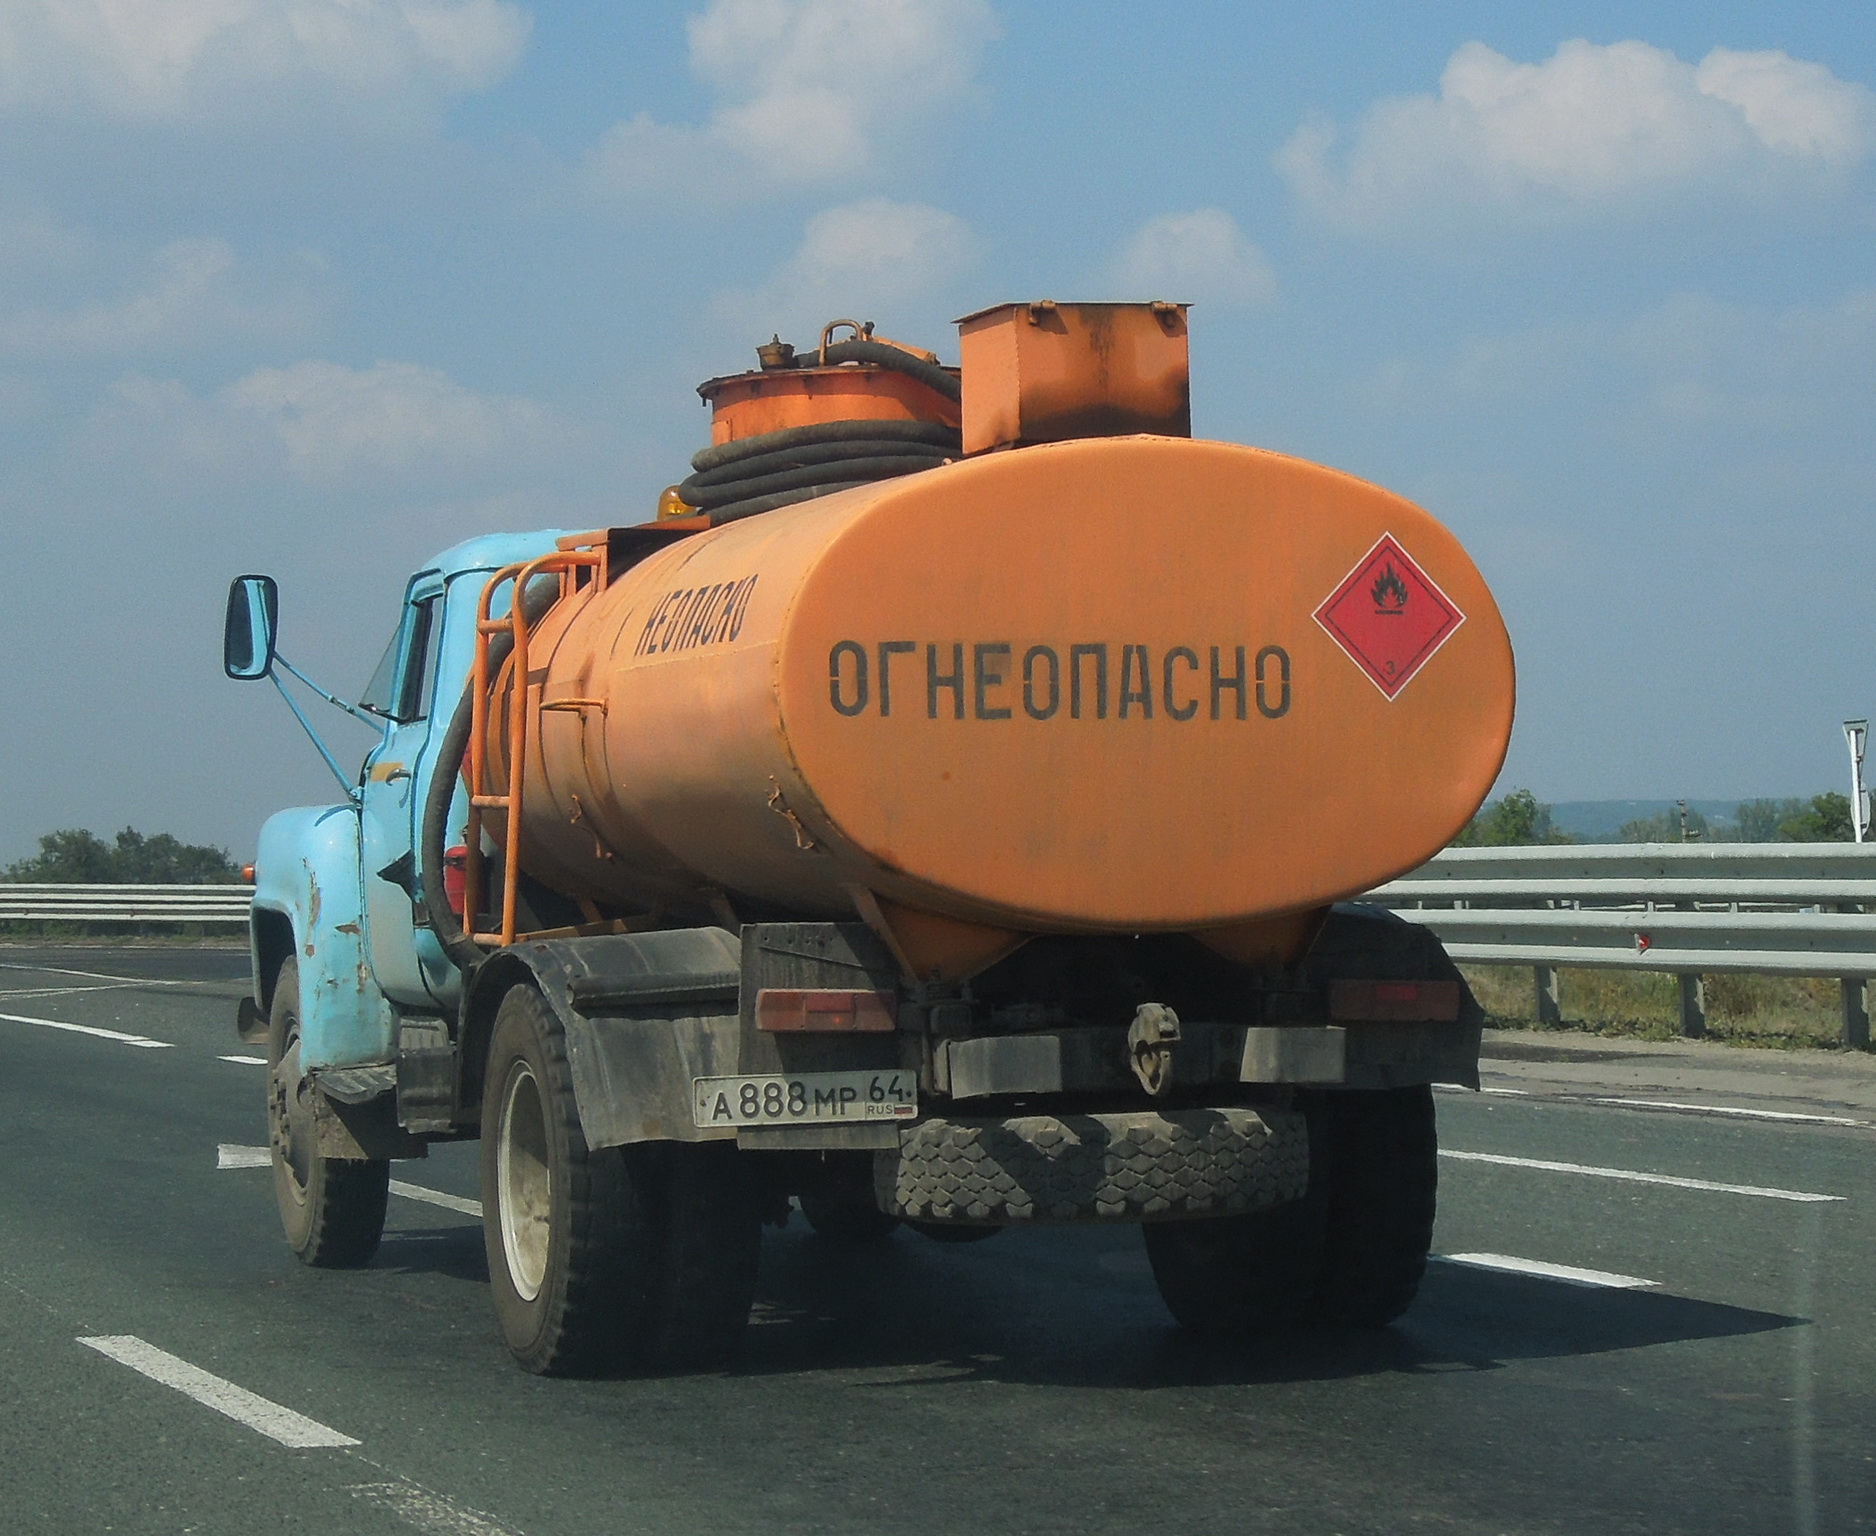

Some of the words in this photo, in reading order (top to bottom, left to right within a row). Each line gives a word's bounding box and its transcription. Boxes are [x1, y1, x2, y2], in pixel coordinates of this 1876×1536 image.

[1385, 661, 1396, 675] 3
[829, 640, 1291, 719] ОГНЕОПАСНО
[867, 1104, 893, 1115] RUS
